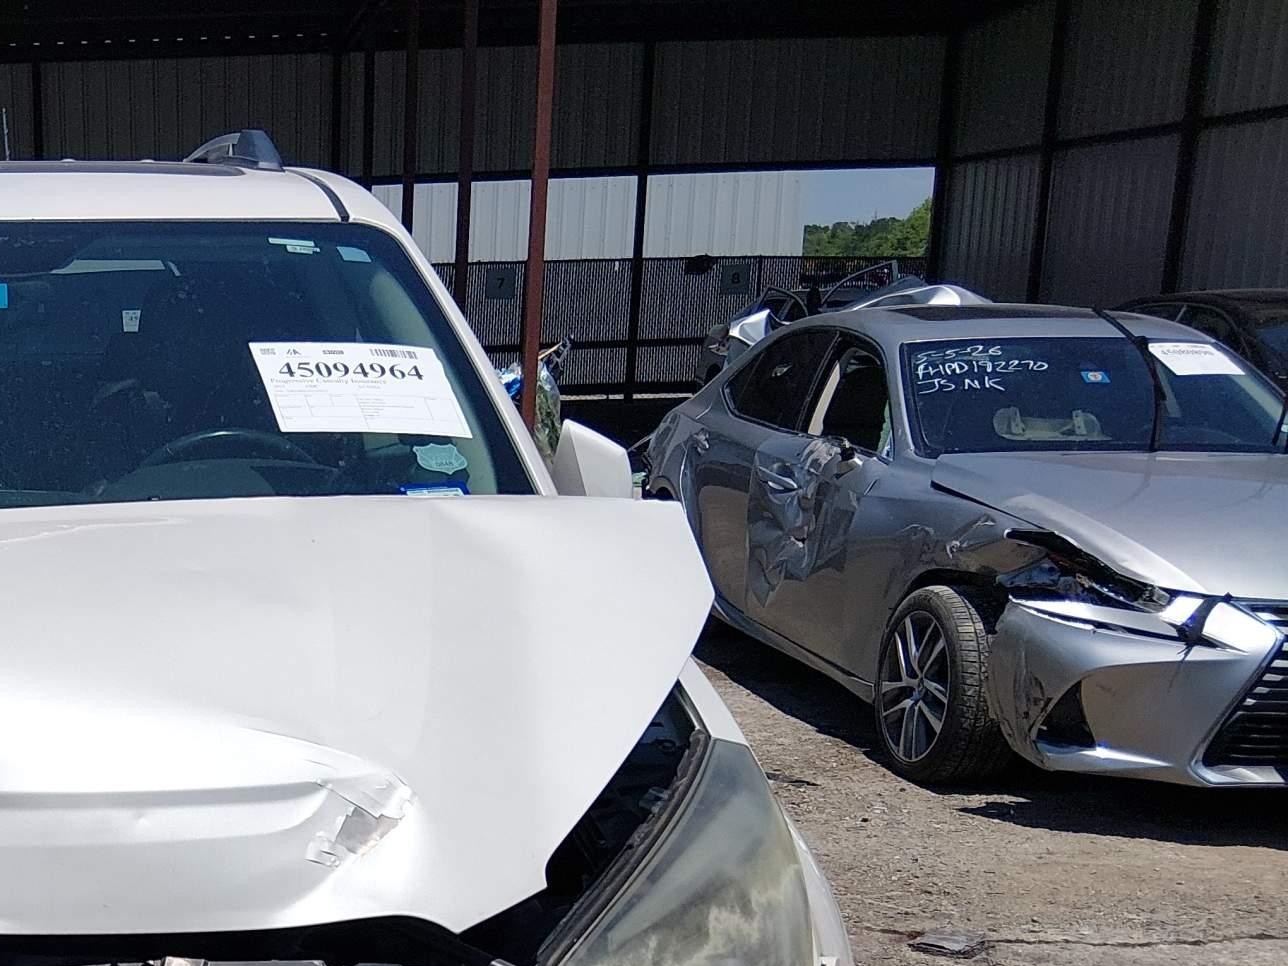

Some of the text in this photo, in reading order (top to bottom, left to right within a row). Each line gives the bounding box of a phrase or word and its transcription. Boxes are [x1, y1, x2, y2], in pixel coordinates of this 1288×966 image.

[497, 277, 505, 289] 7
[915, 345, 1002, 364] 5-5-26
[278, 361, 424, 380] 45094964
